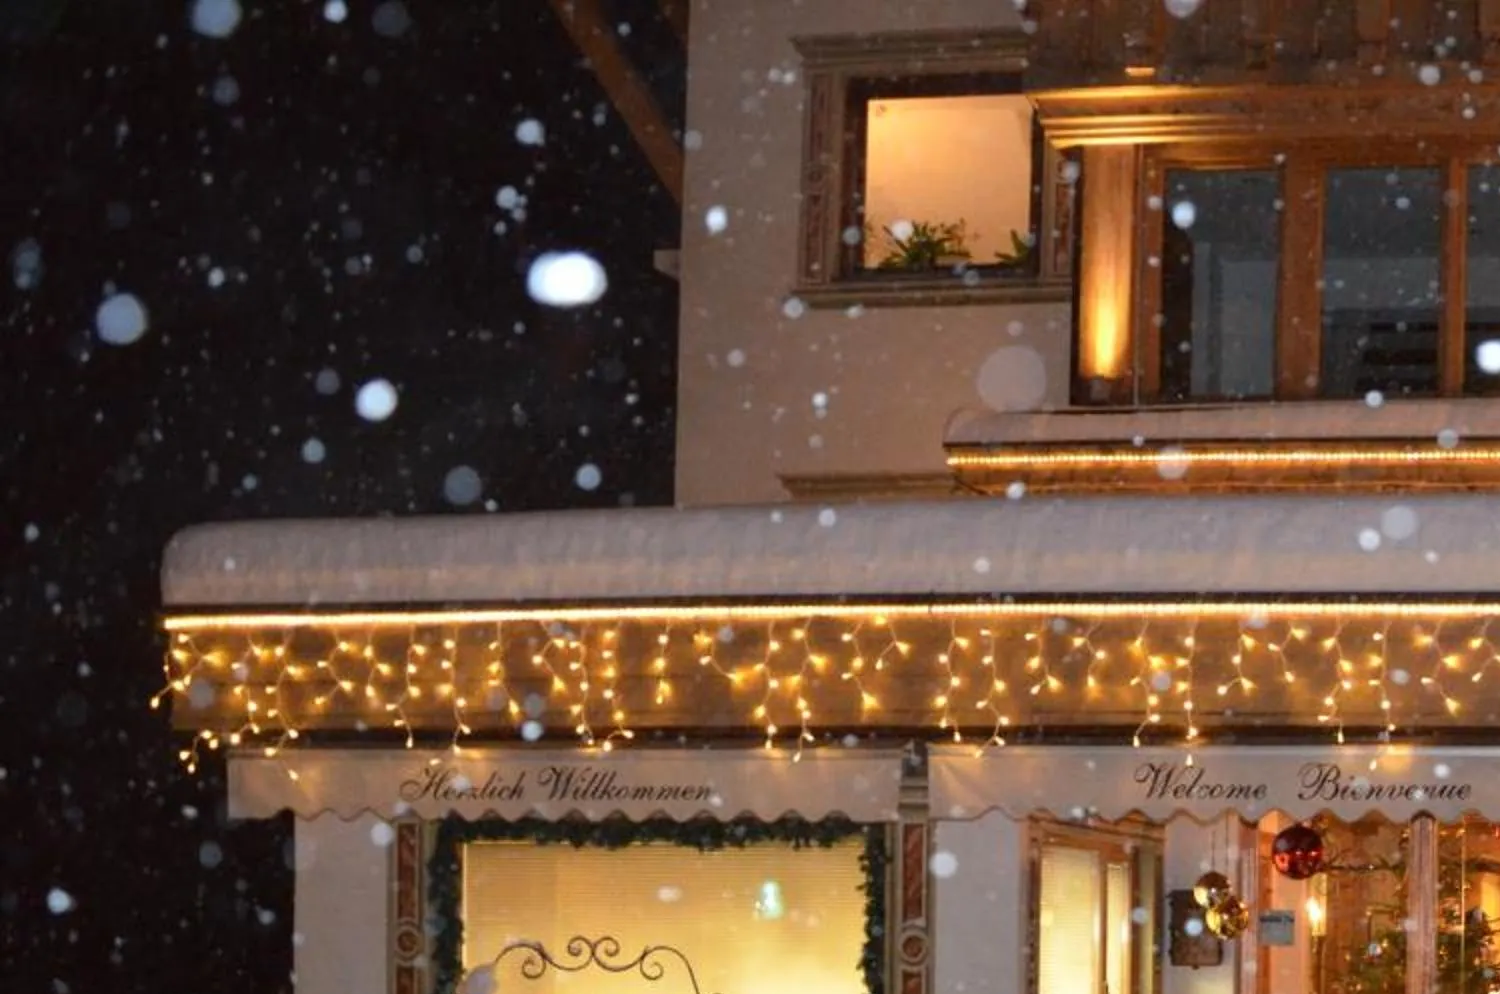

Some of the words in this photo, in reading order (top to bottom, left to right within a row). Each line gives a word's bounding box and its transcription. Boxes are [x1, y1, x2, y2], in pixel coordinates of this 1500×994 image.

[537, 765, 712, 801] Willkommen
[1135, 762, 1267, 800] Welcome
[1297, 762, 1472, 801] Bienvenue
